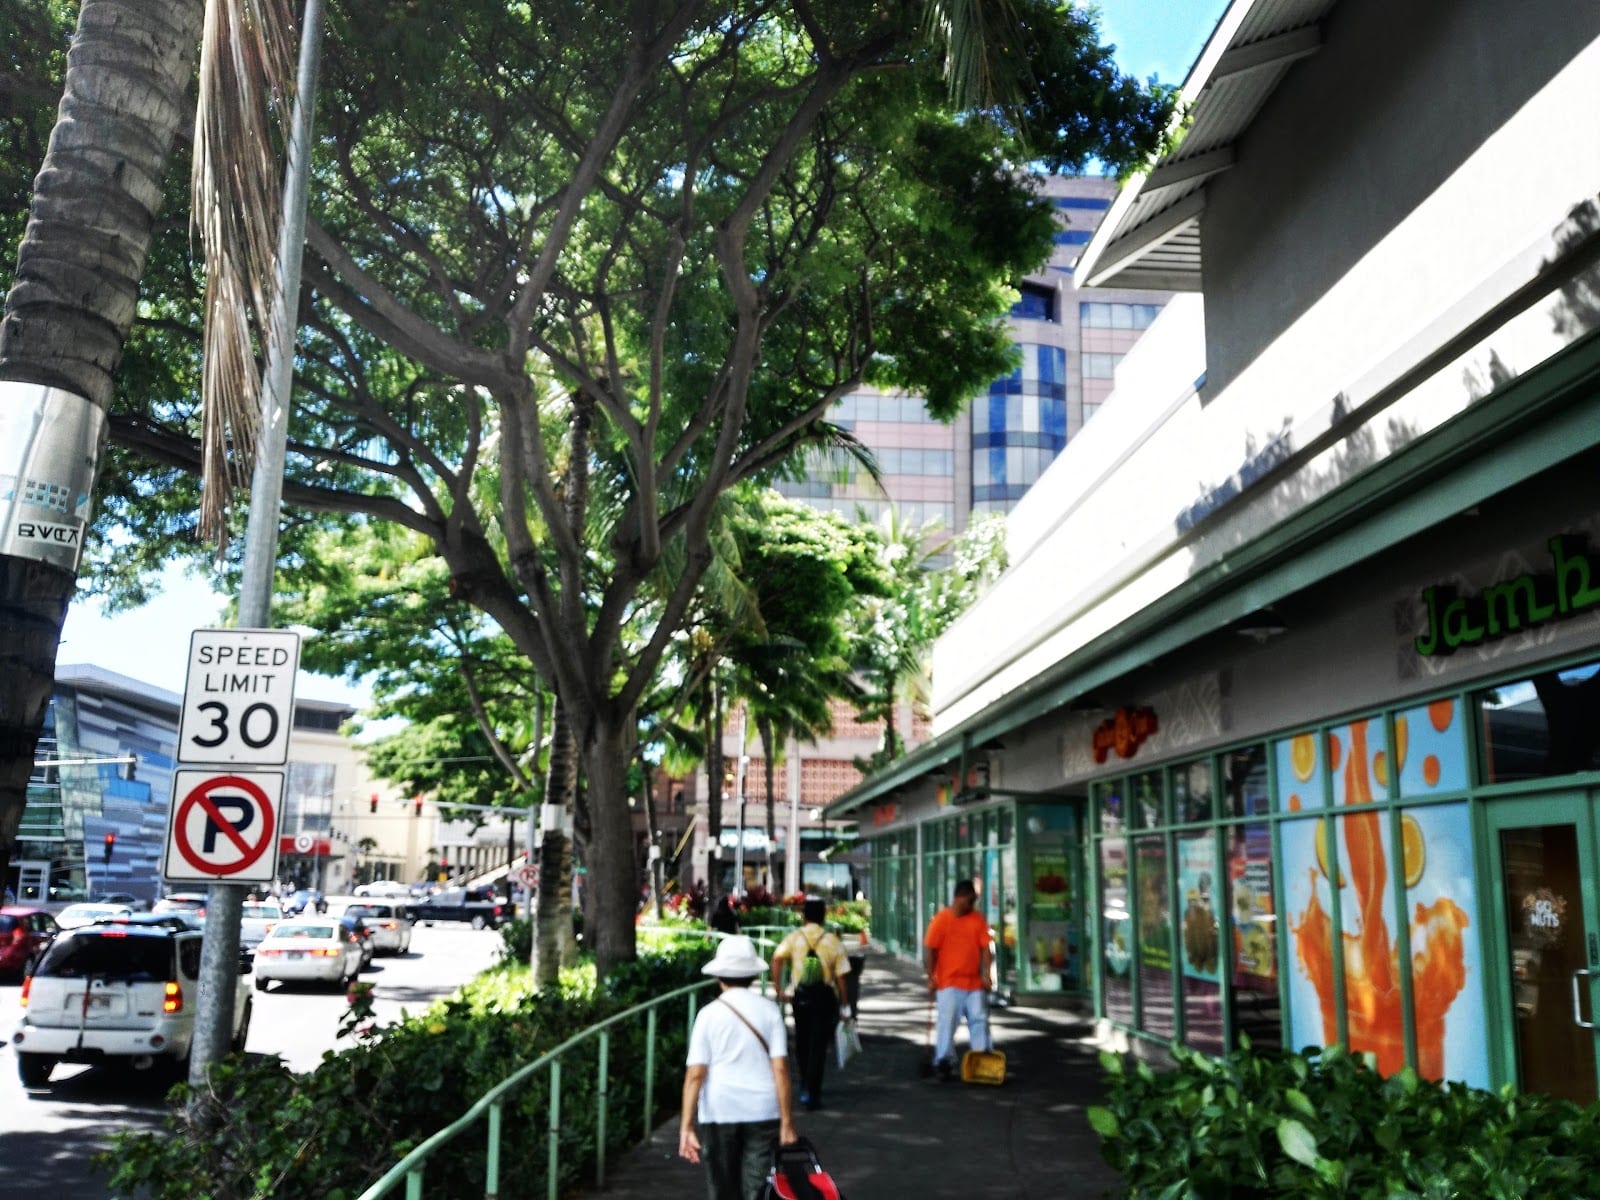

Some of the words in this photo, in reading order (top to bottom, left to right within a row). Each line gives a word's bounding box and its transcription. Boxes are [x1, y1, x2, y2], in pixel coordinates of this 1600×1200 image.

[198, 646, 289, 666] SPEED
[204, 673, 276, 693] LIMIT
[191, 701, 279, 749] 30
[202, 795, 255, 853] P
